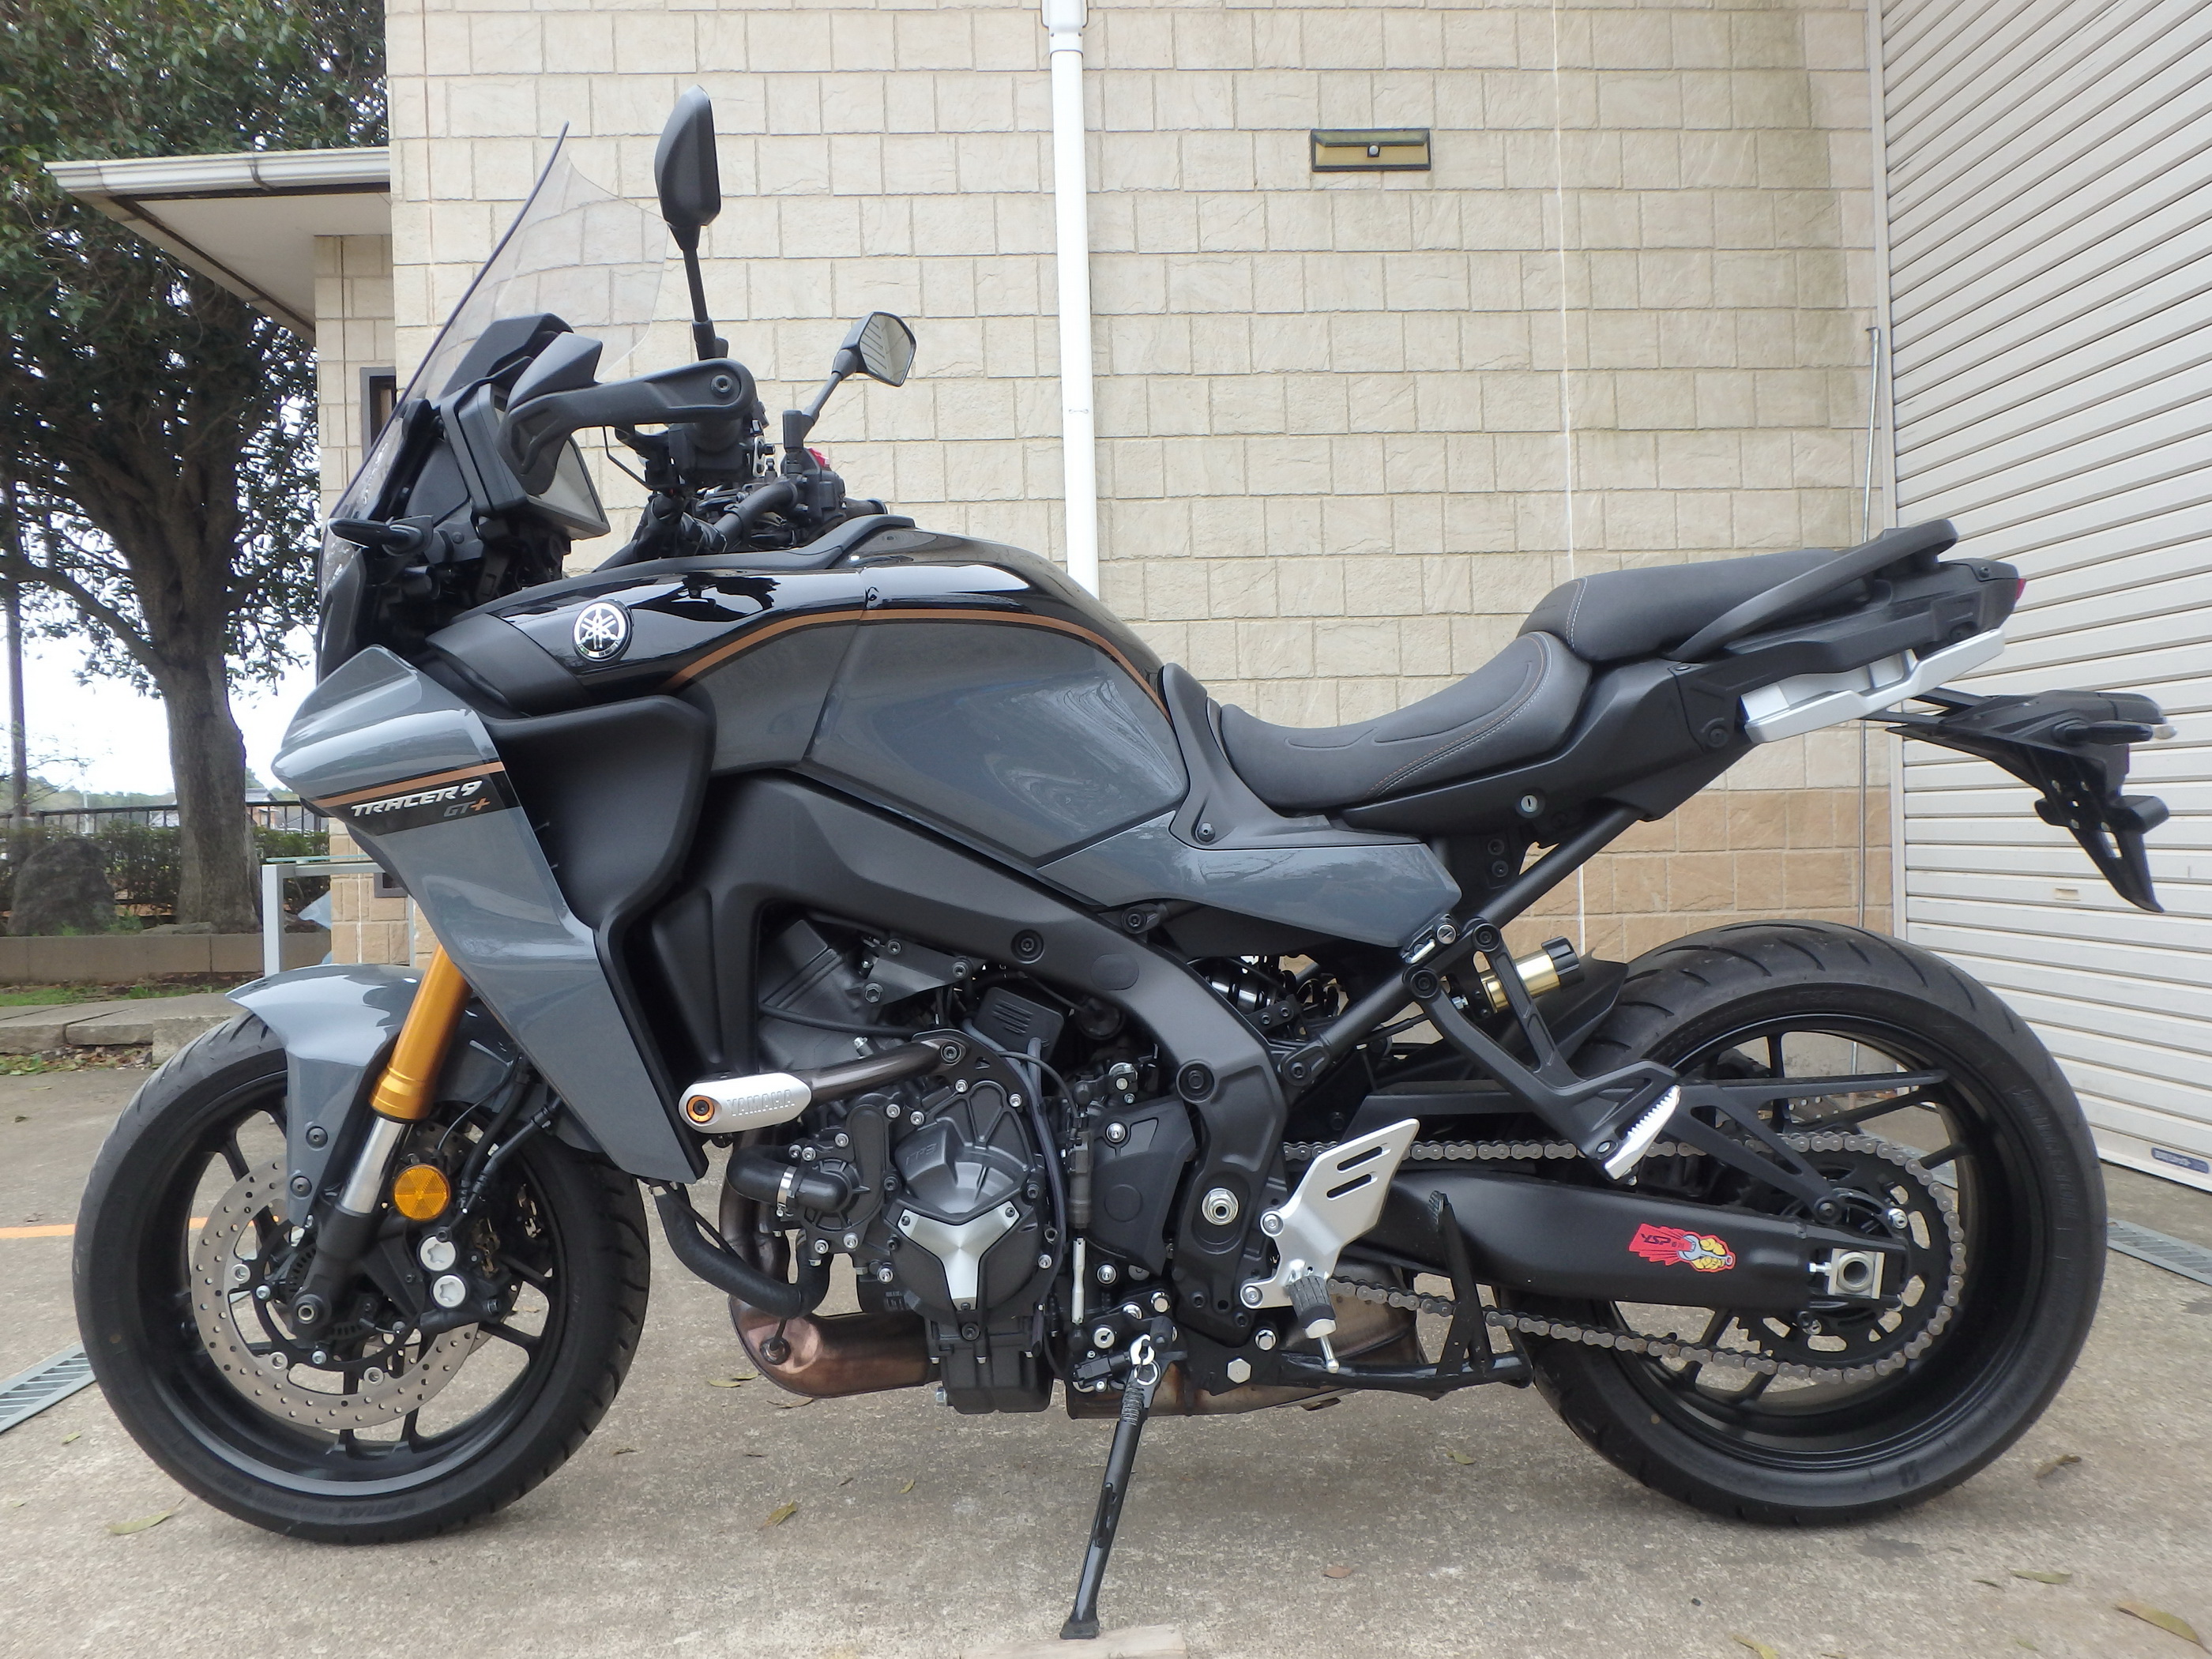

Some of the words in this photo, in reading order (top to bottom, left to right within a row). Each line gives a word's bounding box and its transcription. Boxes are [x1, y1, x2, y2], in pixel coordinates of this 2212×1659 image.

[351, 785, 460, 817] TRACER
[460, 780, 483, 797] 9
[443, 796, 491, 818] GT+
[727, 1089, 796, 1117] YAMAHA
[1640, 1232, 1672, 1246] YSP
